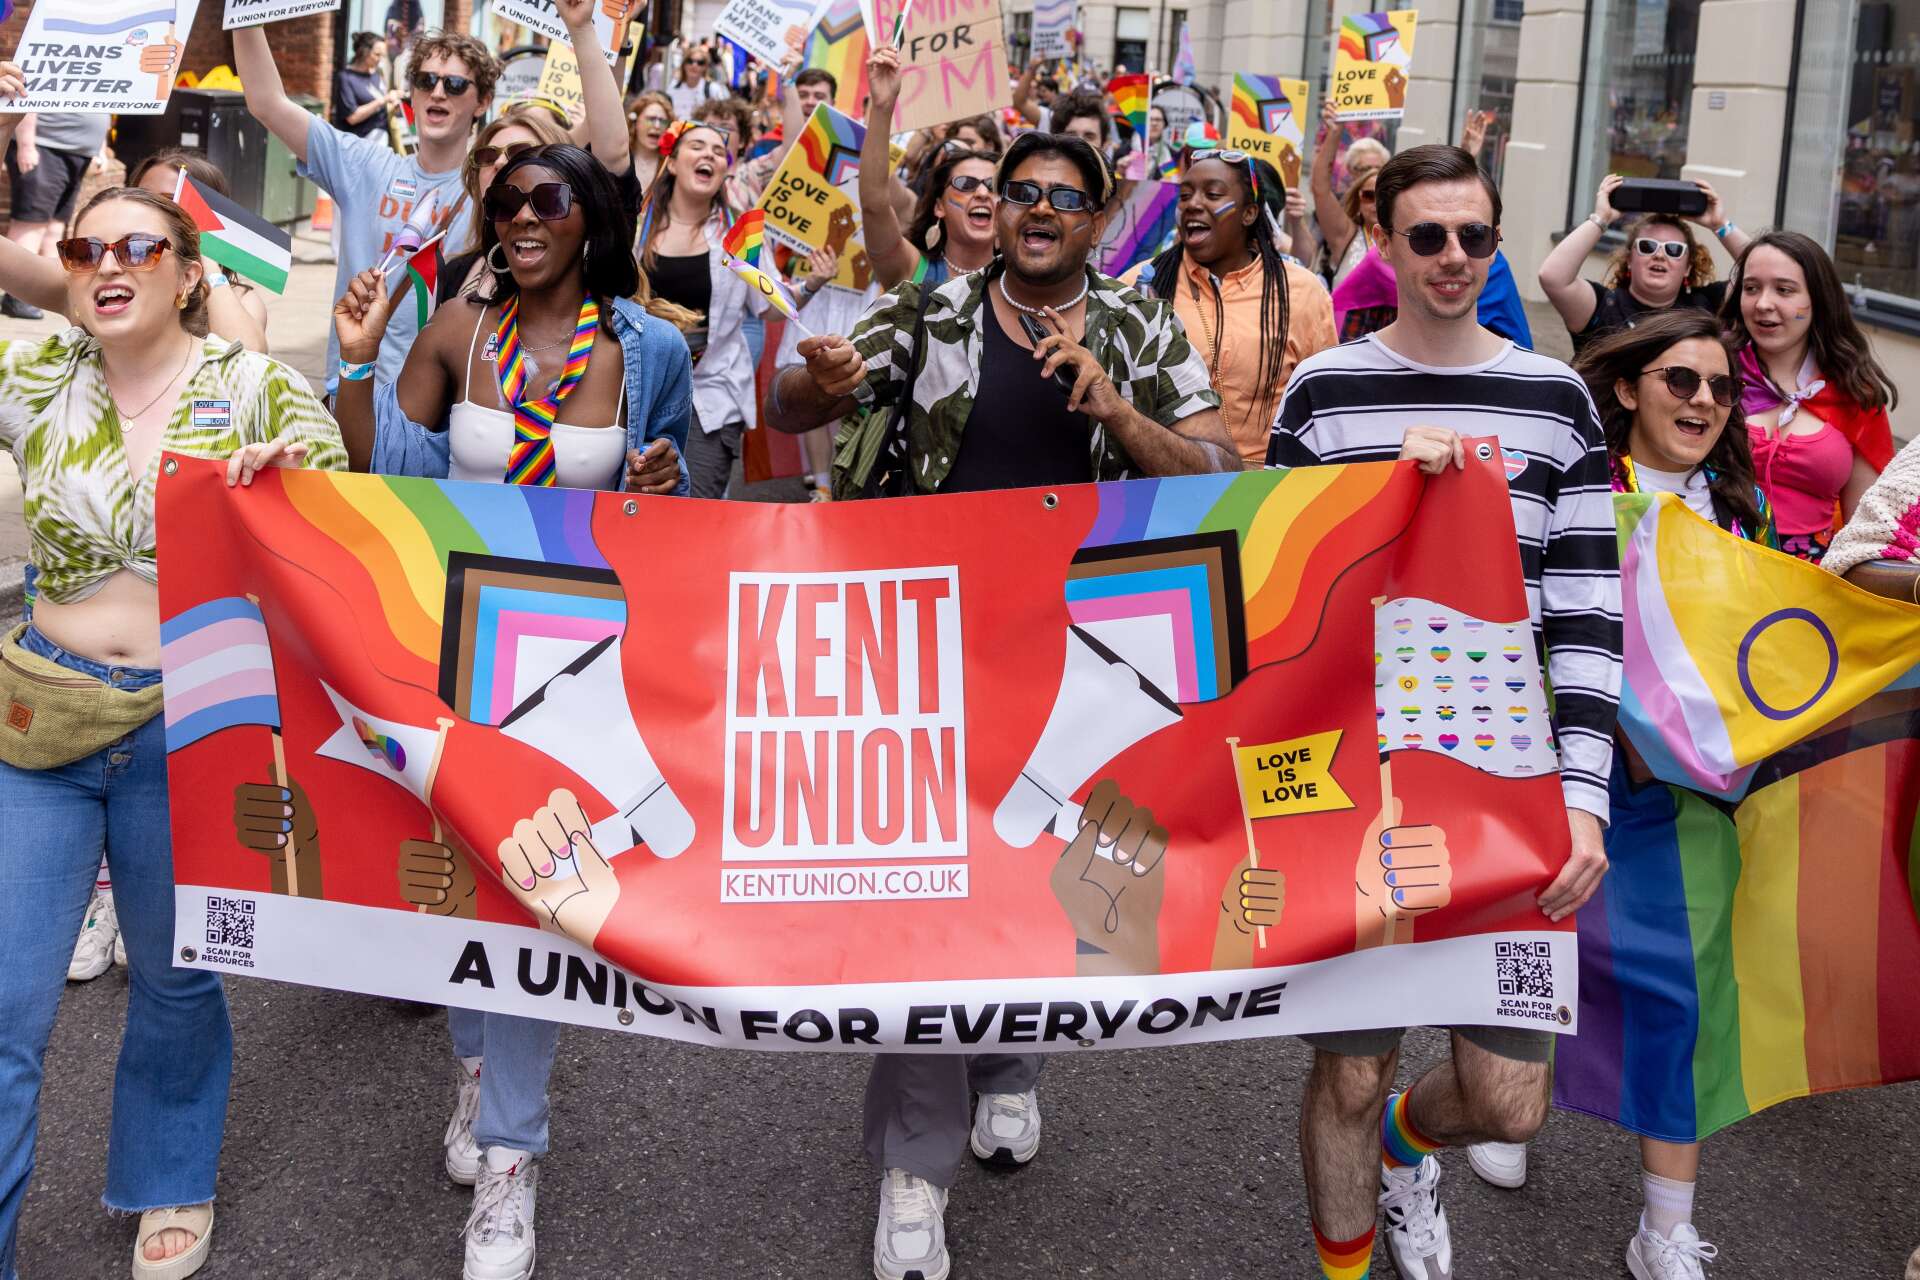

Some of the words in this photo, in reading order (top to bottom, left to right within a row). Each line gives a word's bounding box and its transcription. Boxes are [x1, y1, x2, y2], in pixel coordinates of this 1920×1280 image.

[237, 12, 266, 23] UNION
[268, 8, 286, 19] FOR
[288, 0, 336, 14] EVERYONE
[500, 5, 507, 13] A
[509, 8, 541, 28] UNION
[542, 23, 564, 39] FOR
[731, 2, 769, 31] LIVES
[741, 0, 783, 25] RANS
[725, 12, 777, 50] MATTER
[28, 43, 124, 60] TRANS
[911, 25, 974, 62] FOR
[21, 60, 103, 76] LIVES
[548, 71, 564, 84] IS
[1337, 69, 1377, 81] LOVE
[894, 39, 996, 132] PM
[1336, 83, 1351, 94] IS
[18, 100, 60, 108] UNION
[92, 101, 162, 110] EVERYONE
[1335, 94, 1374, 106] LOVE
[1231, 137, 1272, 153] LOVE
[771, 186, 792, 203] IS
[780, 171, 829, 205] LOVE
[762, 199, 812, 234] LOVE
[736, 577, 950, 717] KENT
[1257, 747, 1311, 771] LOVE
[1277, 768, 1297, 783] IS
[733, 727, 957, 848] UNION
[1262, 783, 1318, 804] LOVE
[726, 870, 962, 897] KENTUNION.CO.UK
[202, 955, 255, 967] RESOURCES
[206, 947, 230, 956] SCAN
[232, 951, 251, 960] FOR
[449, 940, 495, 989] A
[517, 948, 722, 1034] UNION
[740, 1008, 883, 1044] FOR
[904, 982, 1288, 1045] EVERYONE
[1497, 1007, 1557, 1021] RESOURCES
[1501, 1000, 1528, 1008] SCAN
[1531, 1002, 1552, 1011] FOR
